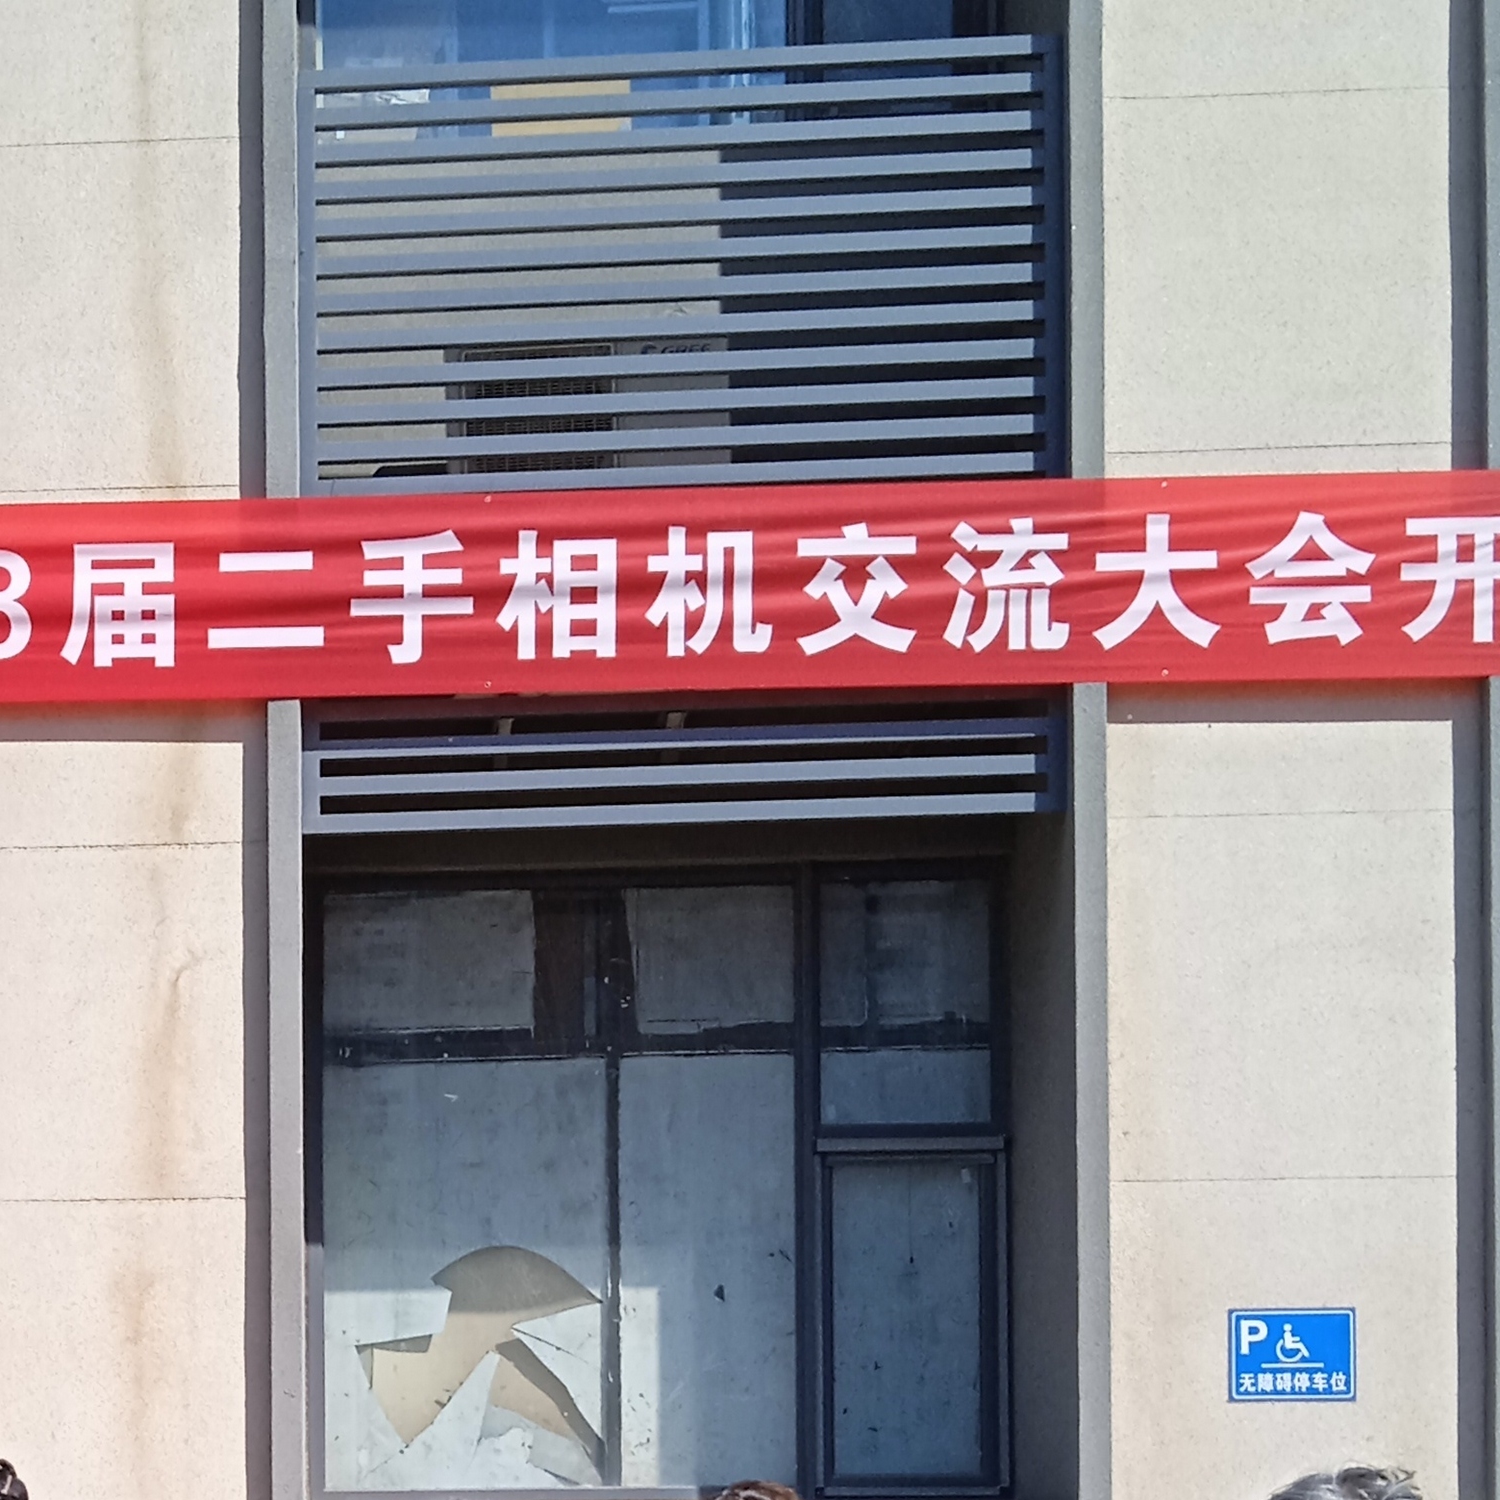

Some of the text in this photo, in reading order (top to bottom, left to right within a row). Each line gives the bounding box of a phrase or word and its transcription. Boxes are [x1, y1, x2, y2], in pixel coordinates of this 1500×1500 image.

[1240, 1319, 1268, 1355] P
[1239, 1371, 1347, 1393] 无障碍停车位
